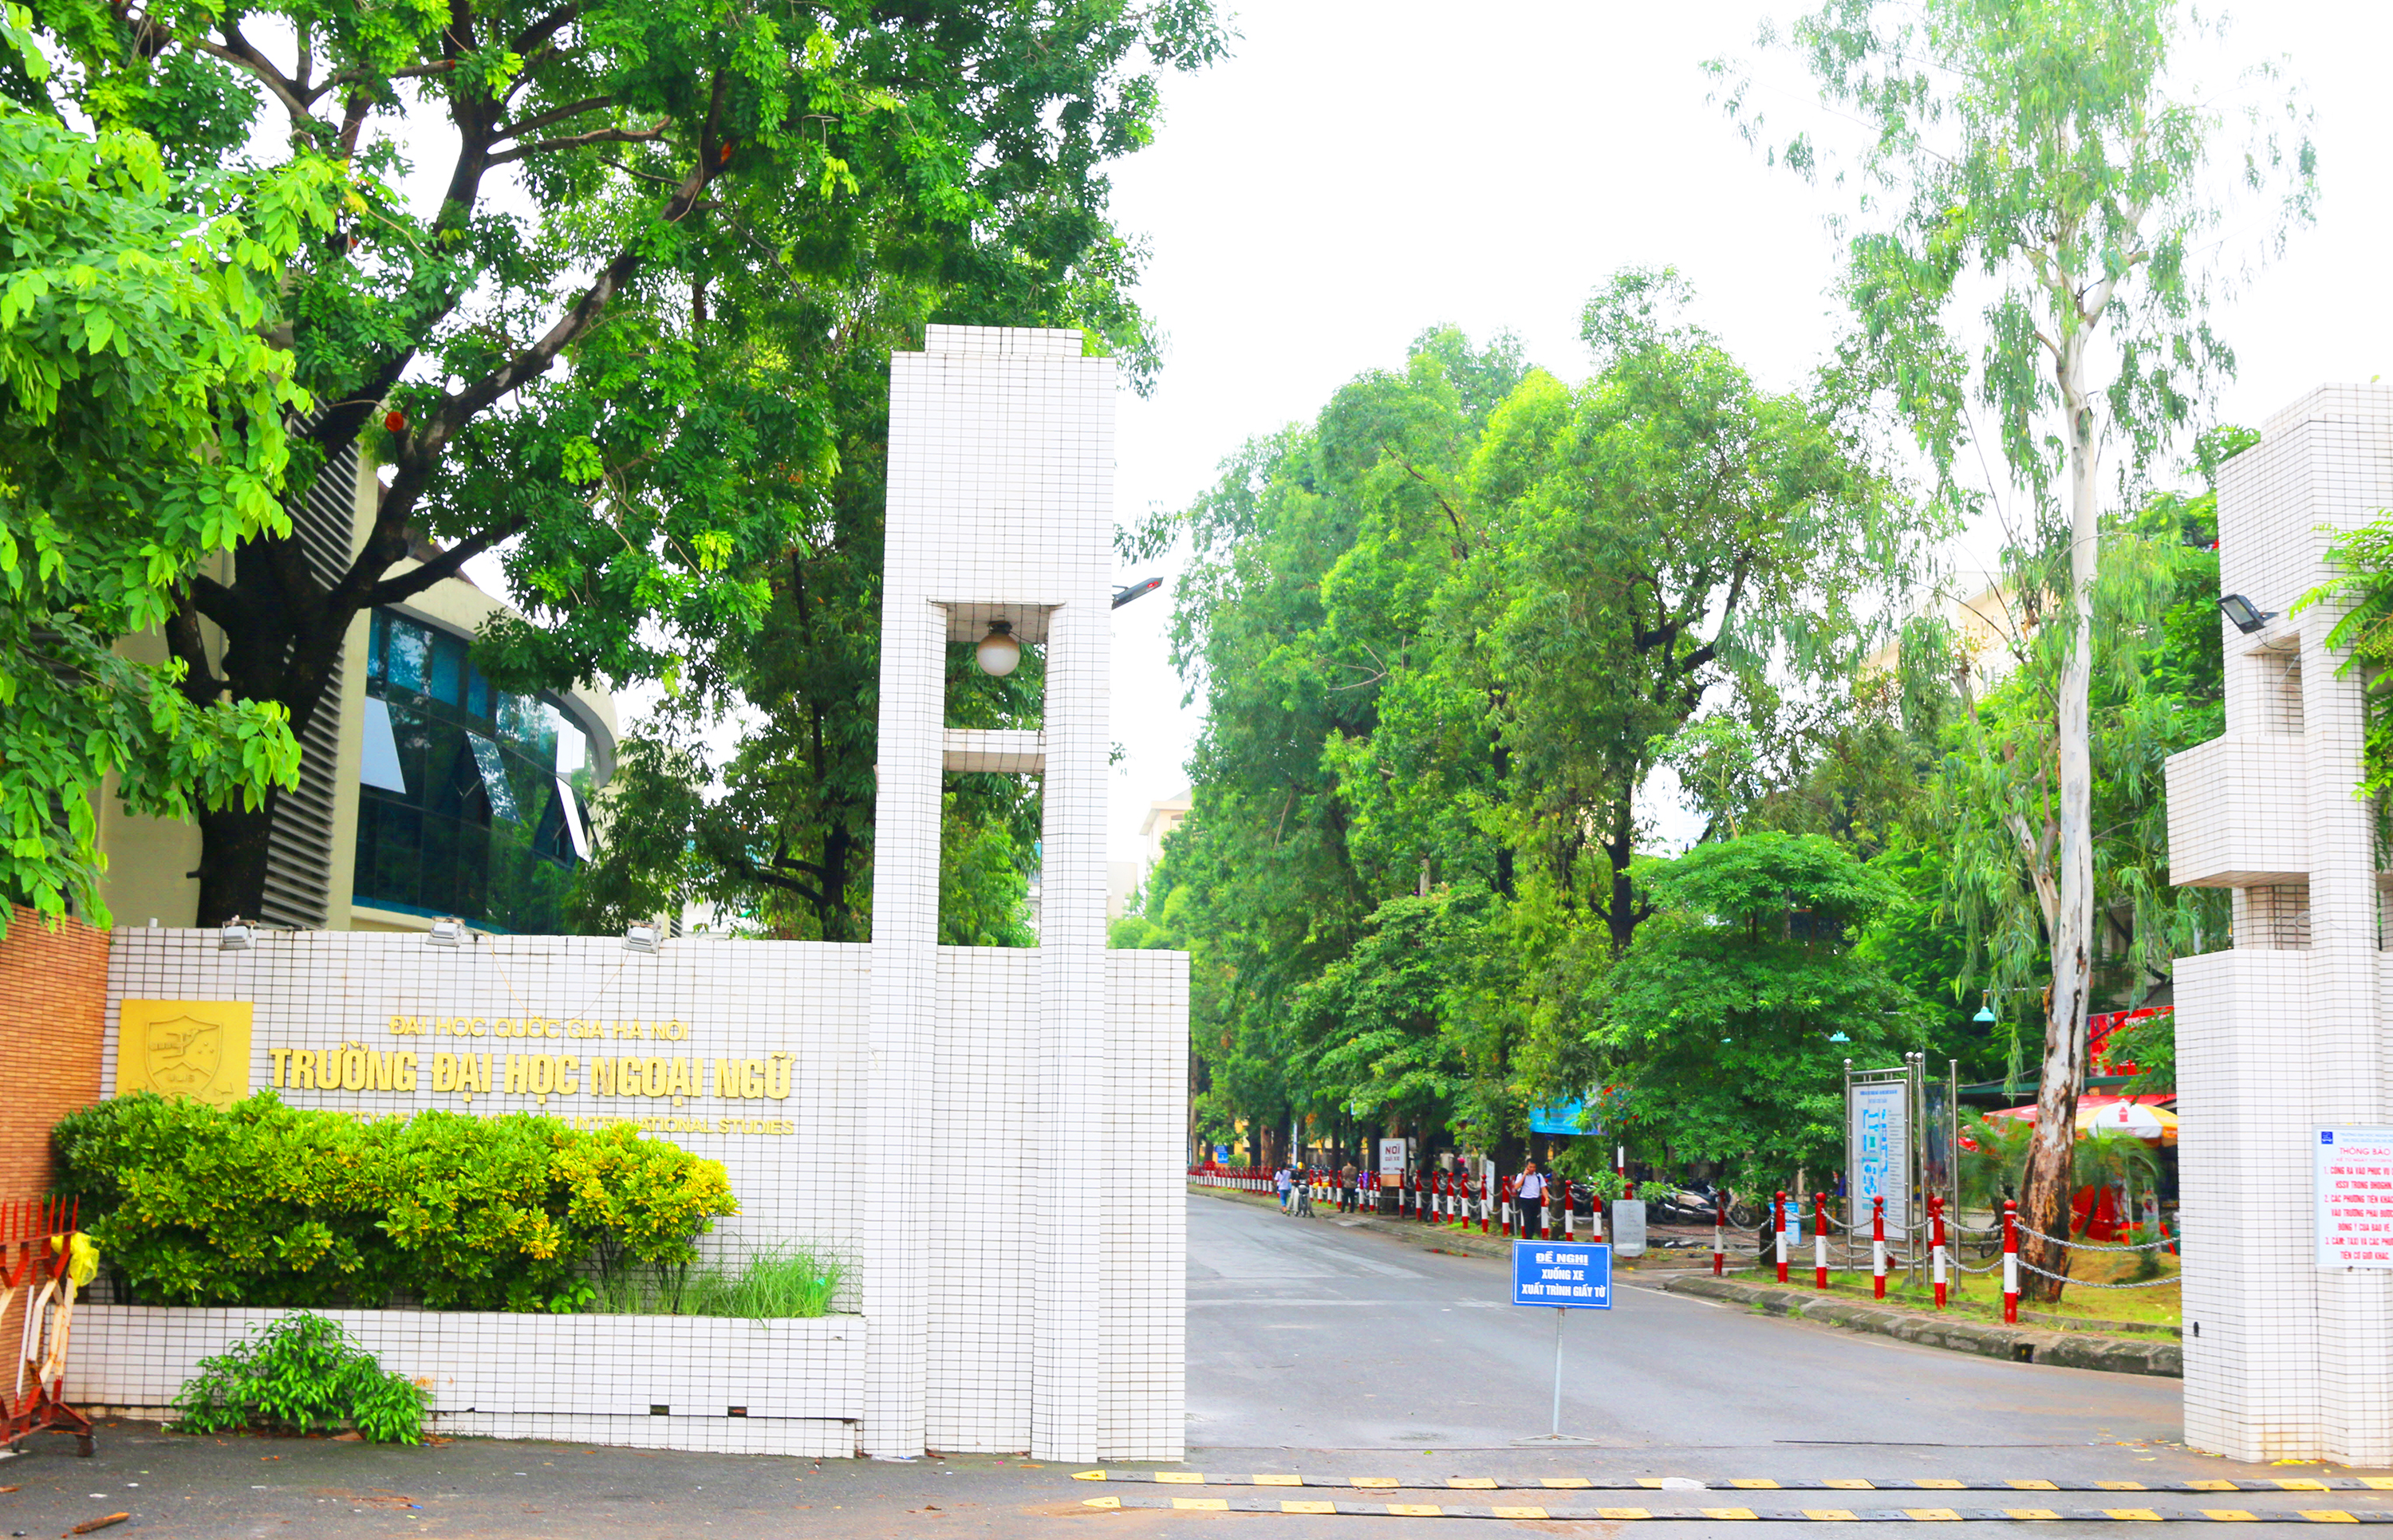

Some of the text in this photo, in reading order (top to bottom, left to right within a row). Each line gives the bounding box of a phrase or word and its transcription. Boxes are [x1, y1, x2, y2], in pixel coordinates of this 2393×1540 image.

[388, 1015, 427, 1038] ĐẠI
[436, 1017, 486, 1038] HỌC
[495, 1014, 561, 1038] QUỐC
[567, 1019, 605, 1039] GIA
[612, 1018, 645, 1040] HÀ
[270, 1041, 796, 1107] TRƯỜNG ĐẠI HỌC NGOẠI NGỮ
[718, 1118, 794, 1136] STUDIES
[2340, 1146, 2370, 1156] THÔNG
[1536, 1251, 1554, 1262] ĐỀ
[1541, 1266, 1584, 1281] XUỐNG XE
[1521, 1282, 1606, 1298] XUẤT TRÌNH GIẤY TỜ
